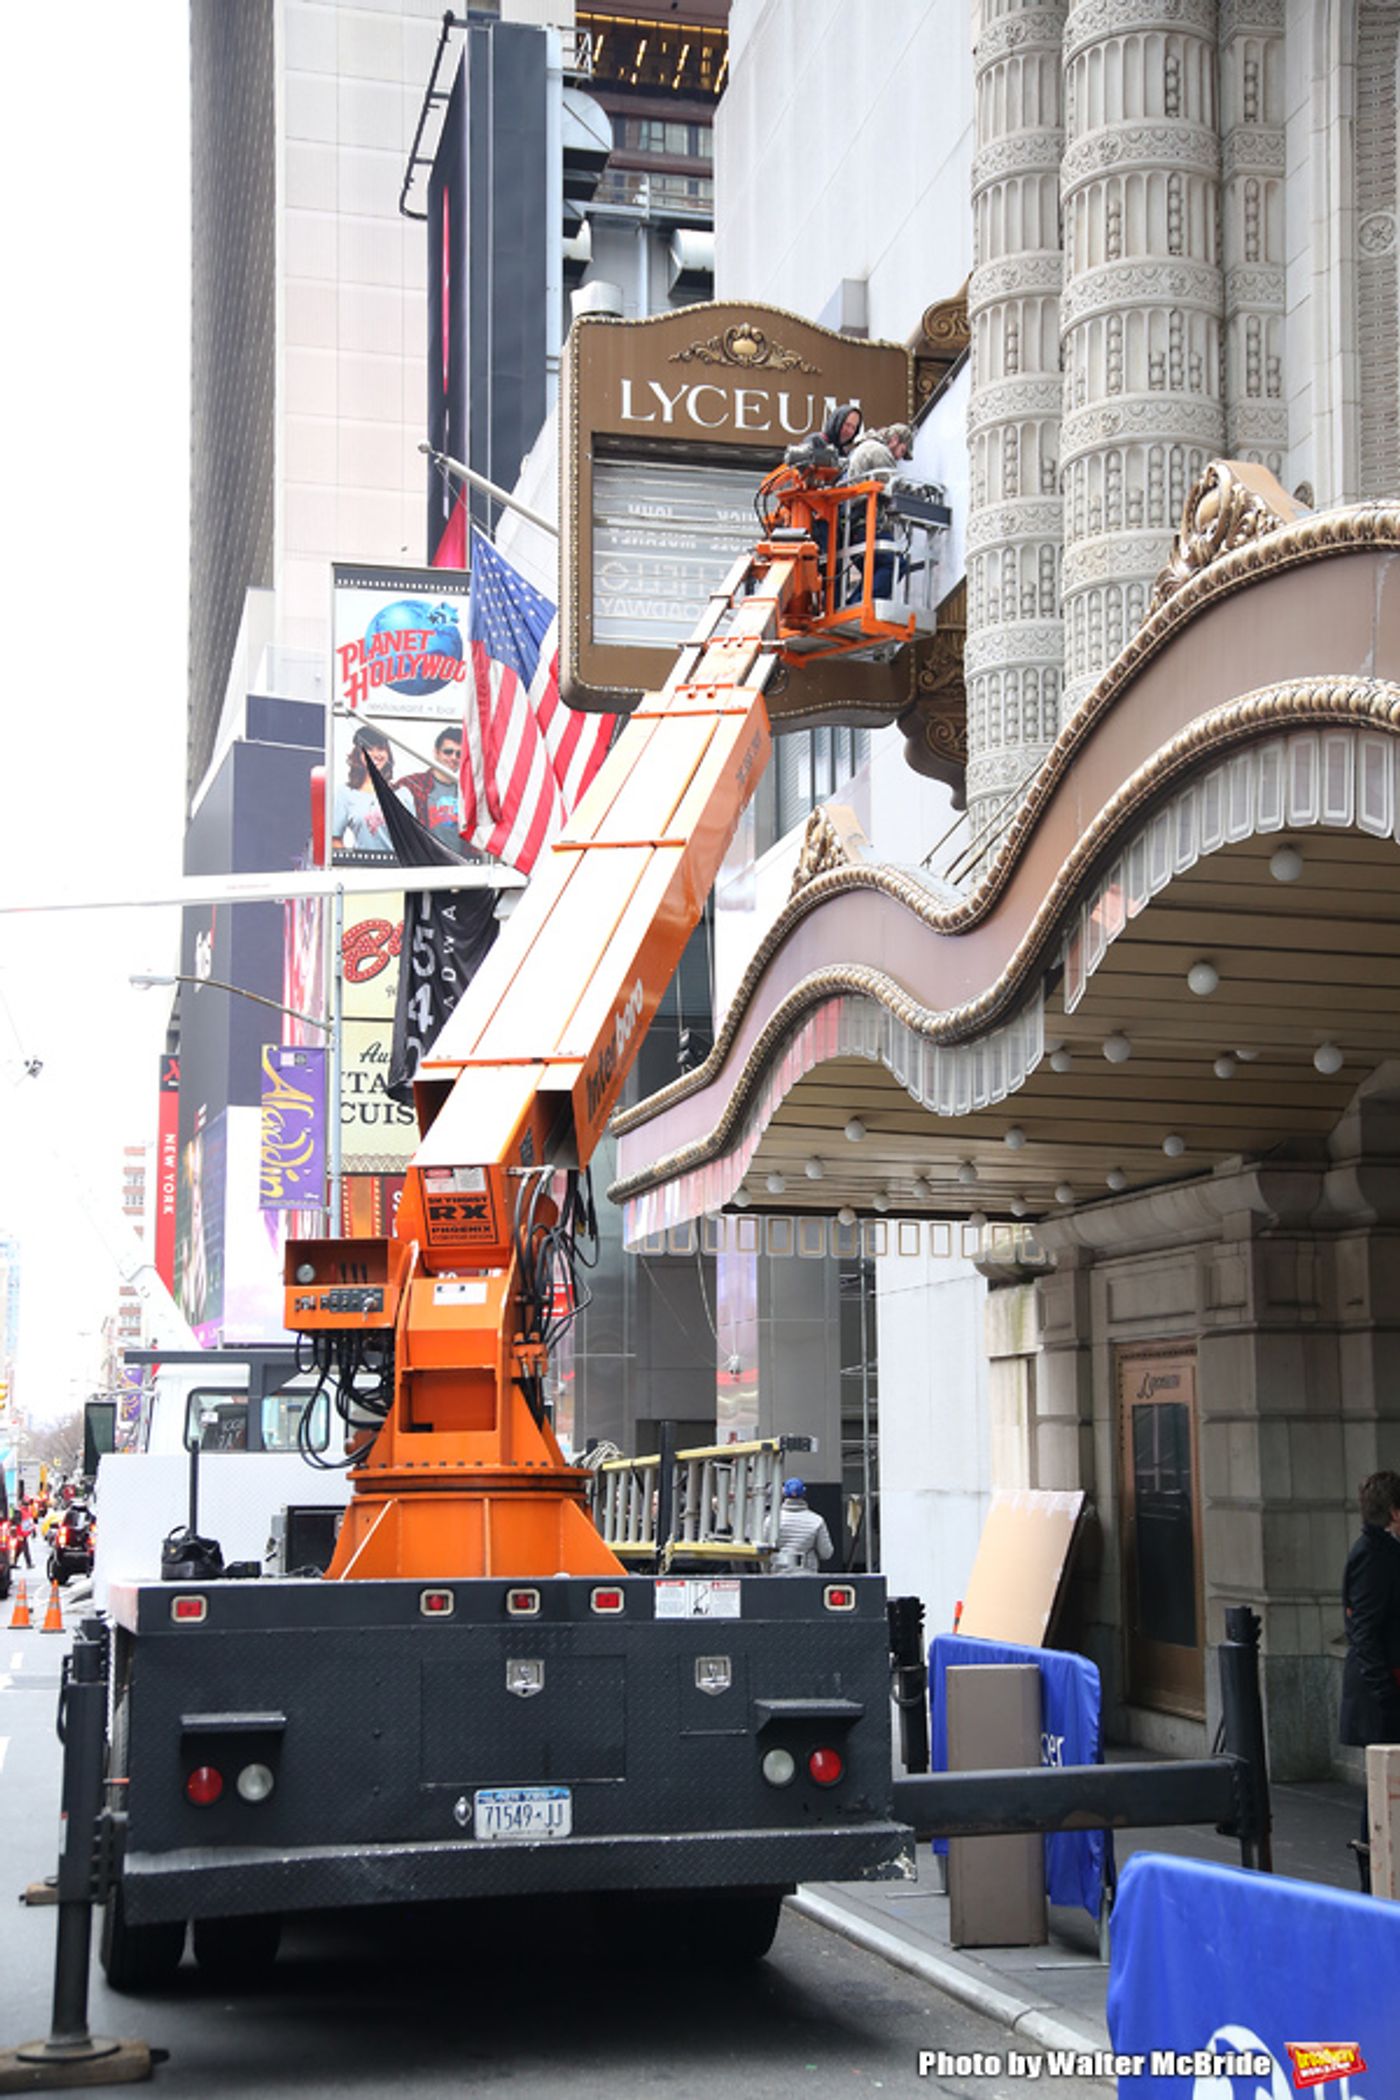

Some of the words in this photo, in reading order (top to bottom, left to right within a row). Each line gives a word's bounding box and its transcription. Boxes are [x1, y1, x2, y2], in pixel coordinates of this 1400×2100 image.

[336, 629, 436, 683] PLANET
[344, 654, 467, 709] HOLLYWOO
[260, 1044, 315, 1198] Aladdin
[341, 1103, 418, 1126] CUIS
[164, 1133, 177, 1167] NEW
[163, 1174, 174, 1214] YORK
[429, 1204, 488, 1221] RX
